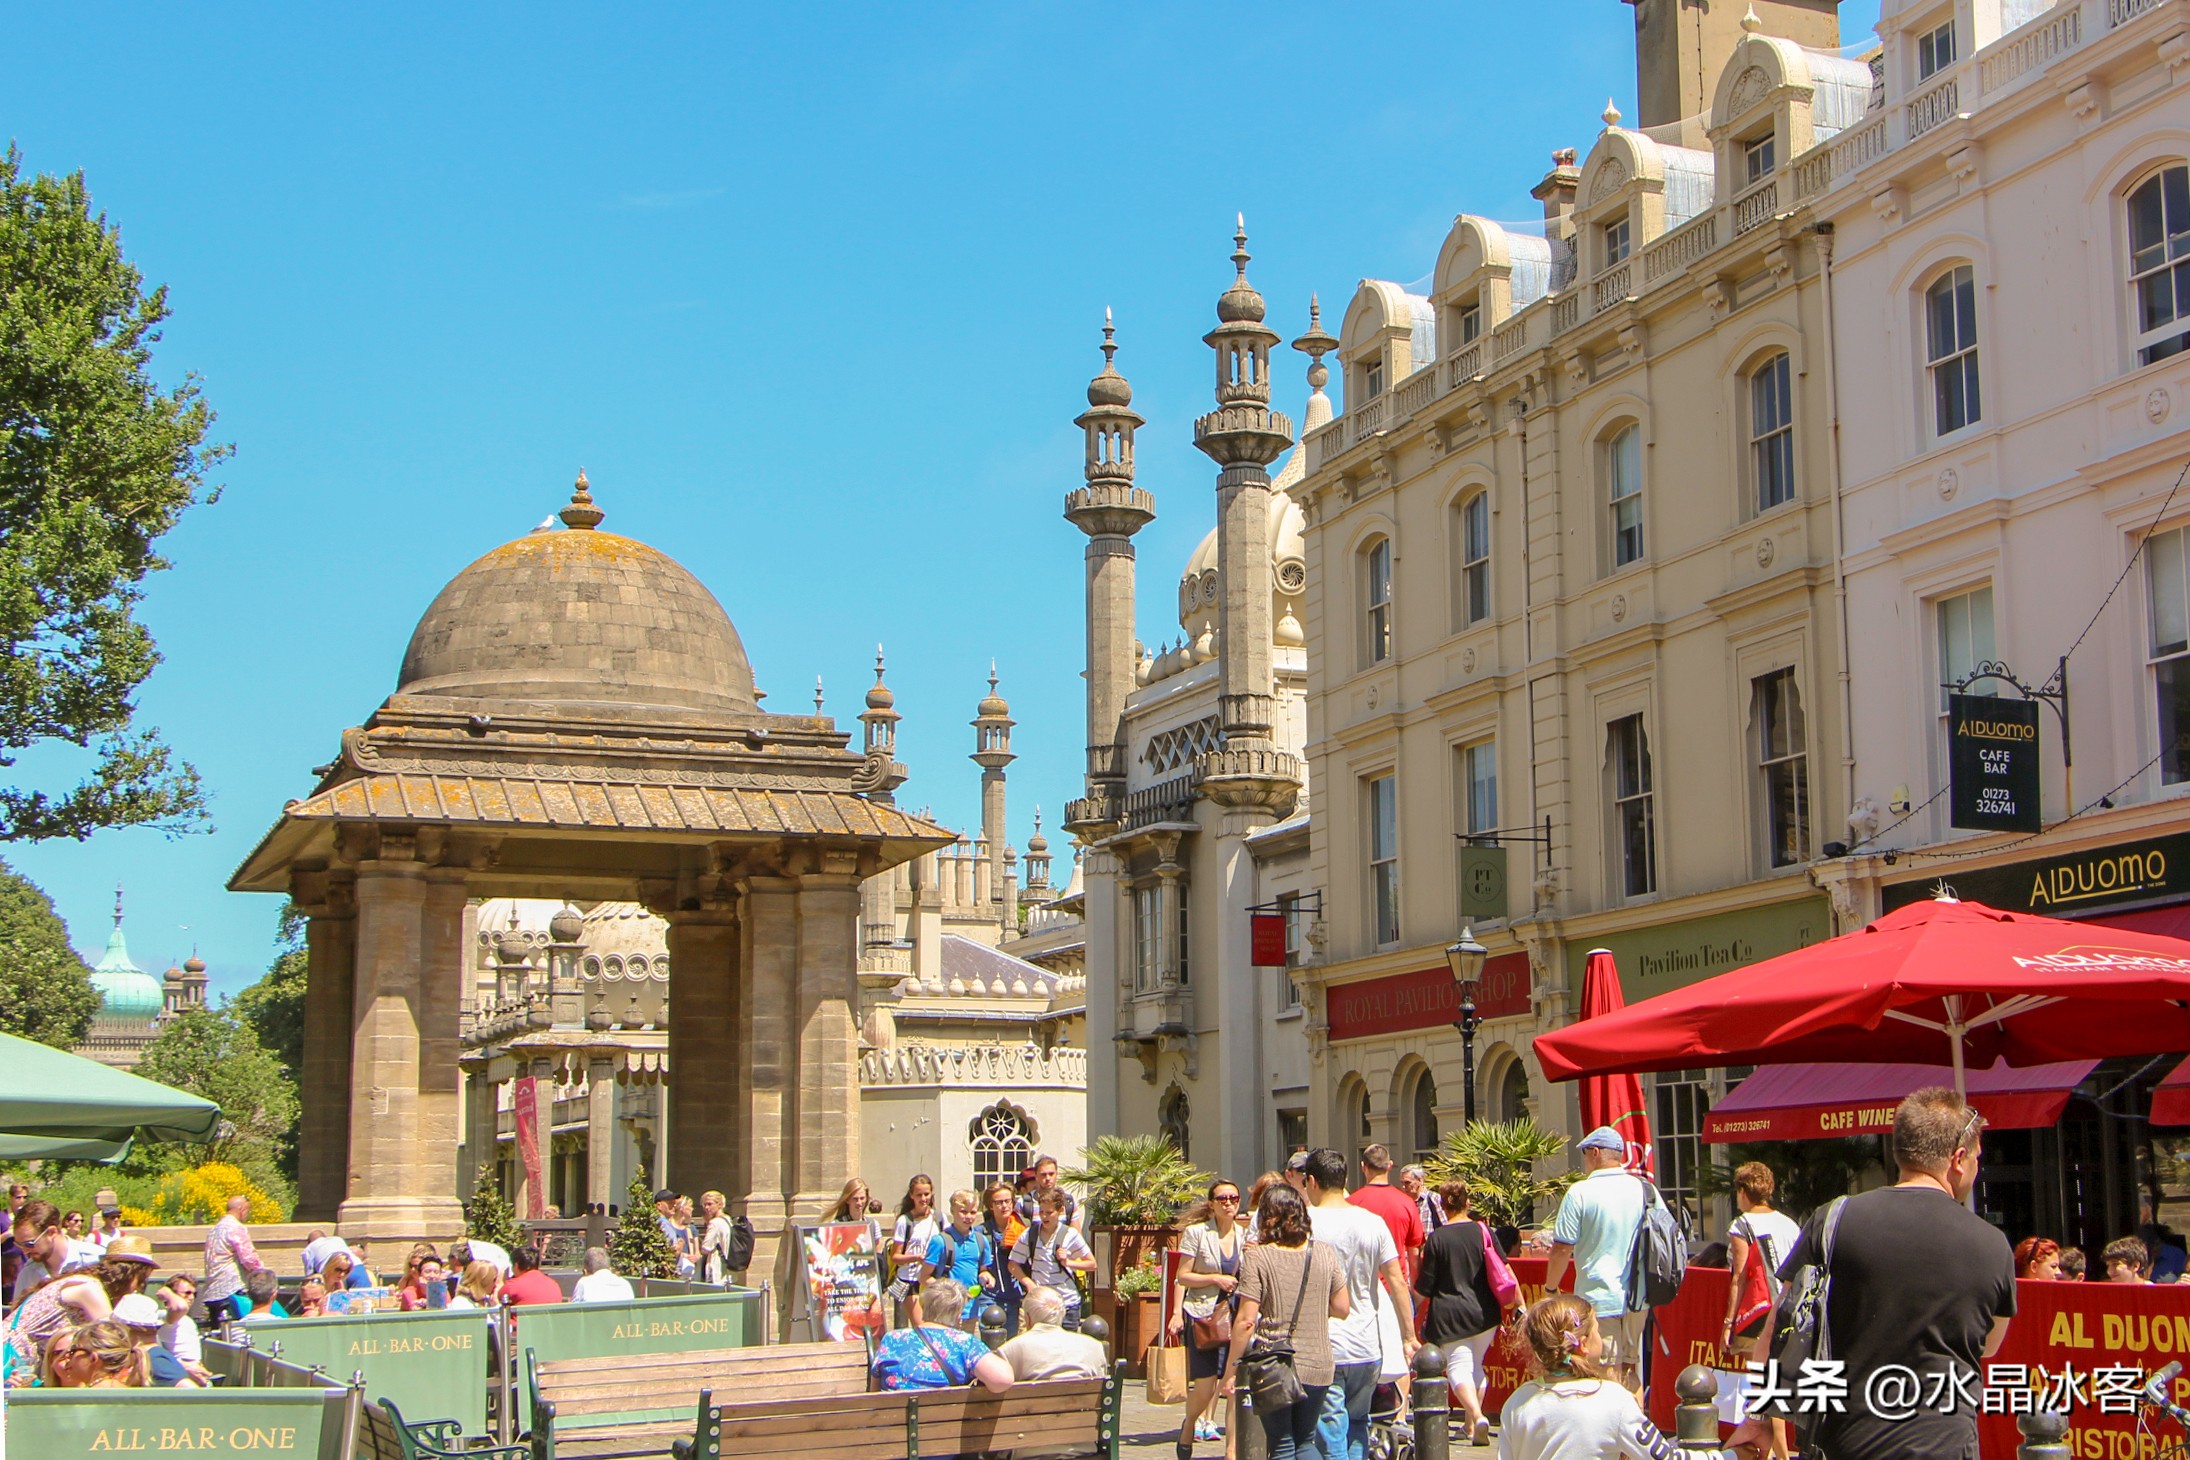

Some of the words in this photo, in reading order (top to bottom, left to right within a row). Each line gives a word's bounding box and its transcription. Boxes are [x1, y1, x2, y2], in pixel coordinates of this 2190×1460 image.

[1979, 749, 2010, 762] CAFE
[1984, 762, 2008, 774] BAR
[1982, 788, 2009, 800] 01273
[1976, 799, 2016, 814] 326741
[1639, 949, 1699, 977] Pavilion
[1700, 944, 1729, 967] Tea
[1345, 992, 1392, 1024] ROYAL
[1472, 972, 1517, 1005] SHOP
[1723, 1121, 1748, 1134] (01273)
[1748, 1119, 1771, 1132] 326741
[1820, 1111, 1854, 1131] CAFE
[1857, 1107, 1896, 1127] WINE
[610, 1324, 644, 1339] ALL
[650, 1321, 685, 1337] BAR
[690, 1318, 729, 1334] ONE
[2049, 1312, 2094, 1349] AL
[347, 1340, 382, 1355] ALL
[389, 1337, 425, 1353] BAR
[431, 1334, 473, 1351] ONE
[89, 1427, 145, 1451] ALL
[157, 1427, 217, 1450] BAR
[229, 1427, 296, 1450] ONE
